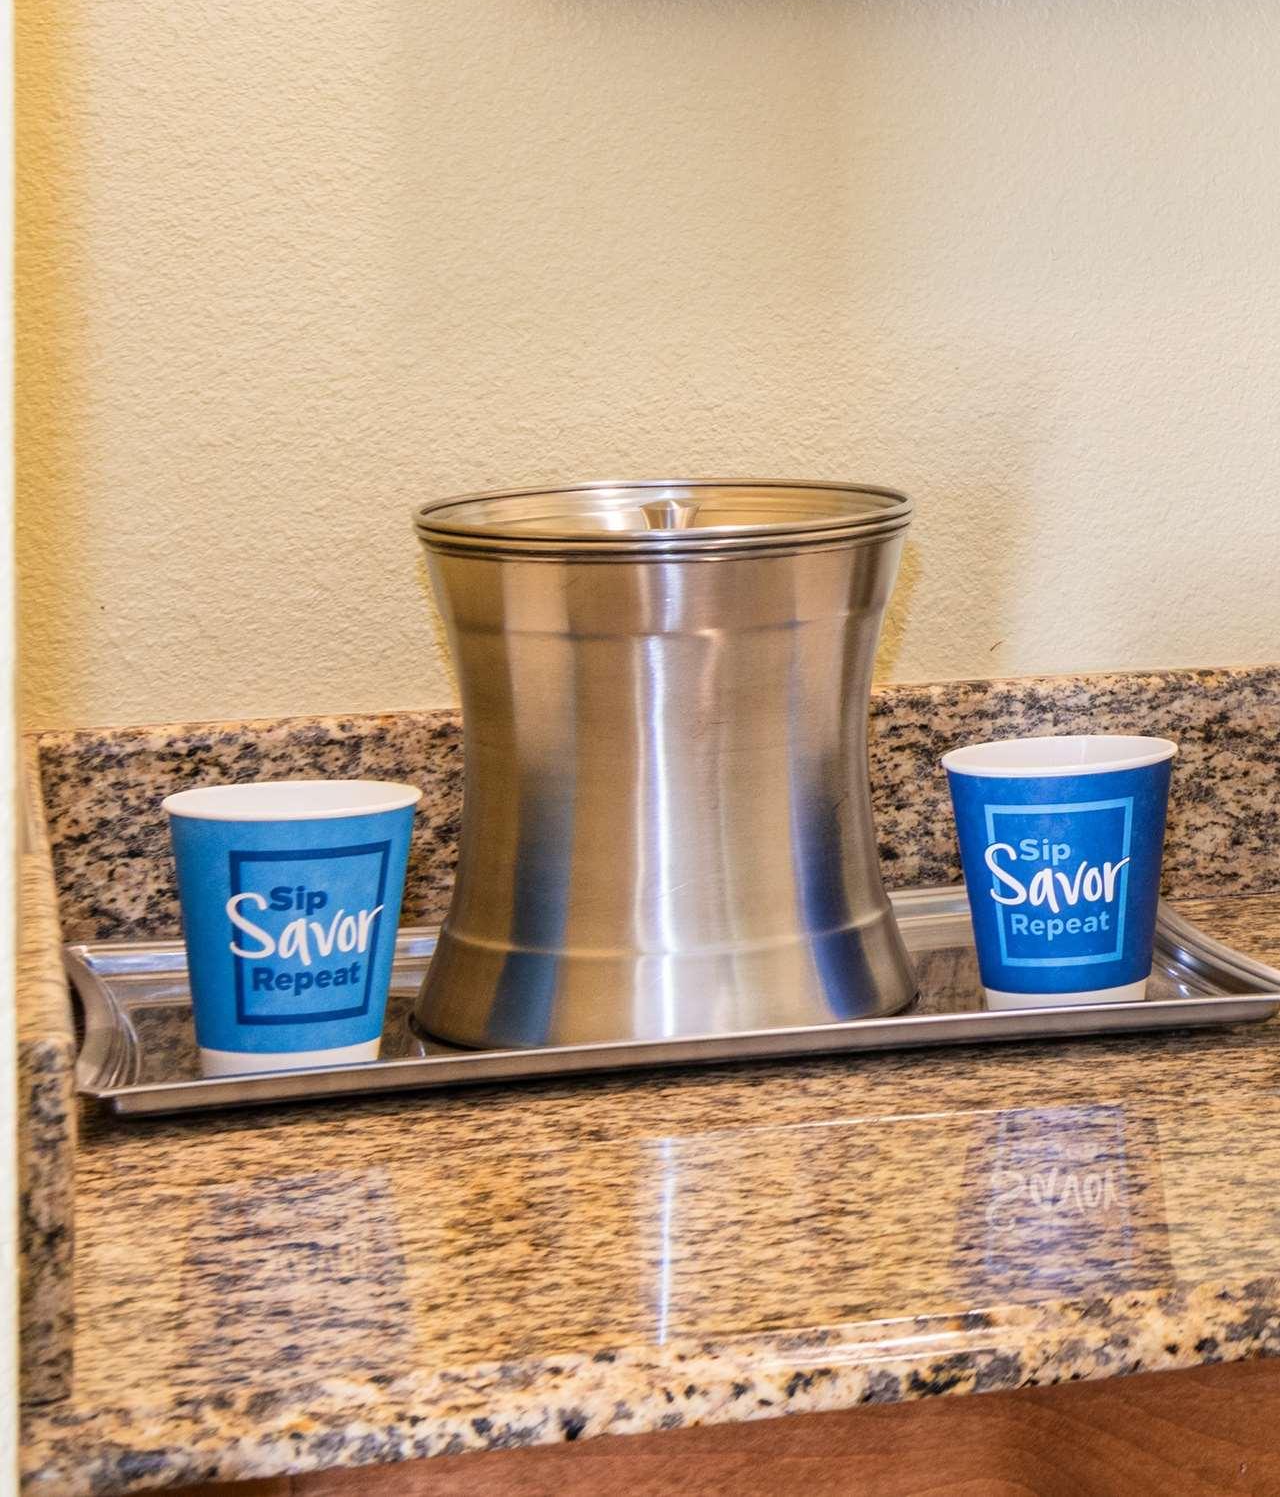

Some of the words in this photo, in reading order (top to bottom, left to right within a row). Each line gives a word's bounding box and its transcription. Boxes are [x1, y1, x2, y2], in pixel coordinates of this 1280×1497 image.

[1018, 838, 1072, 866] Sip
[983, 842, 1131, 914] Savor
[268, 886, 328, 916] Sip
[225, 892, 385, 967] Savor
[1009, 911, 1111, 942] Repeat
[252, 962, 361, 996] Repeat
